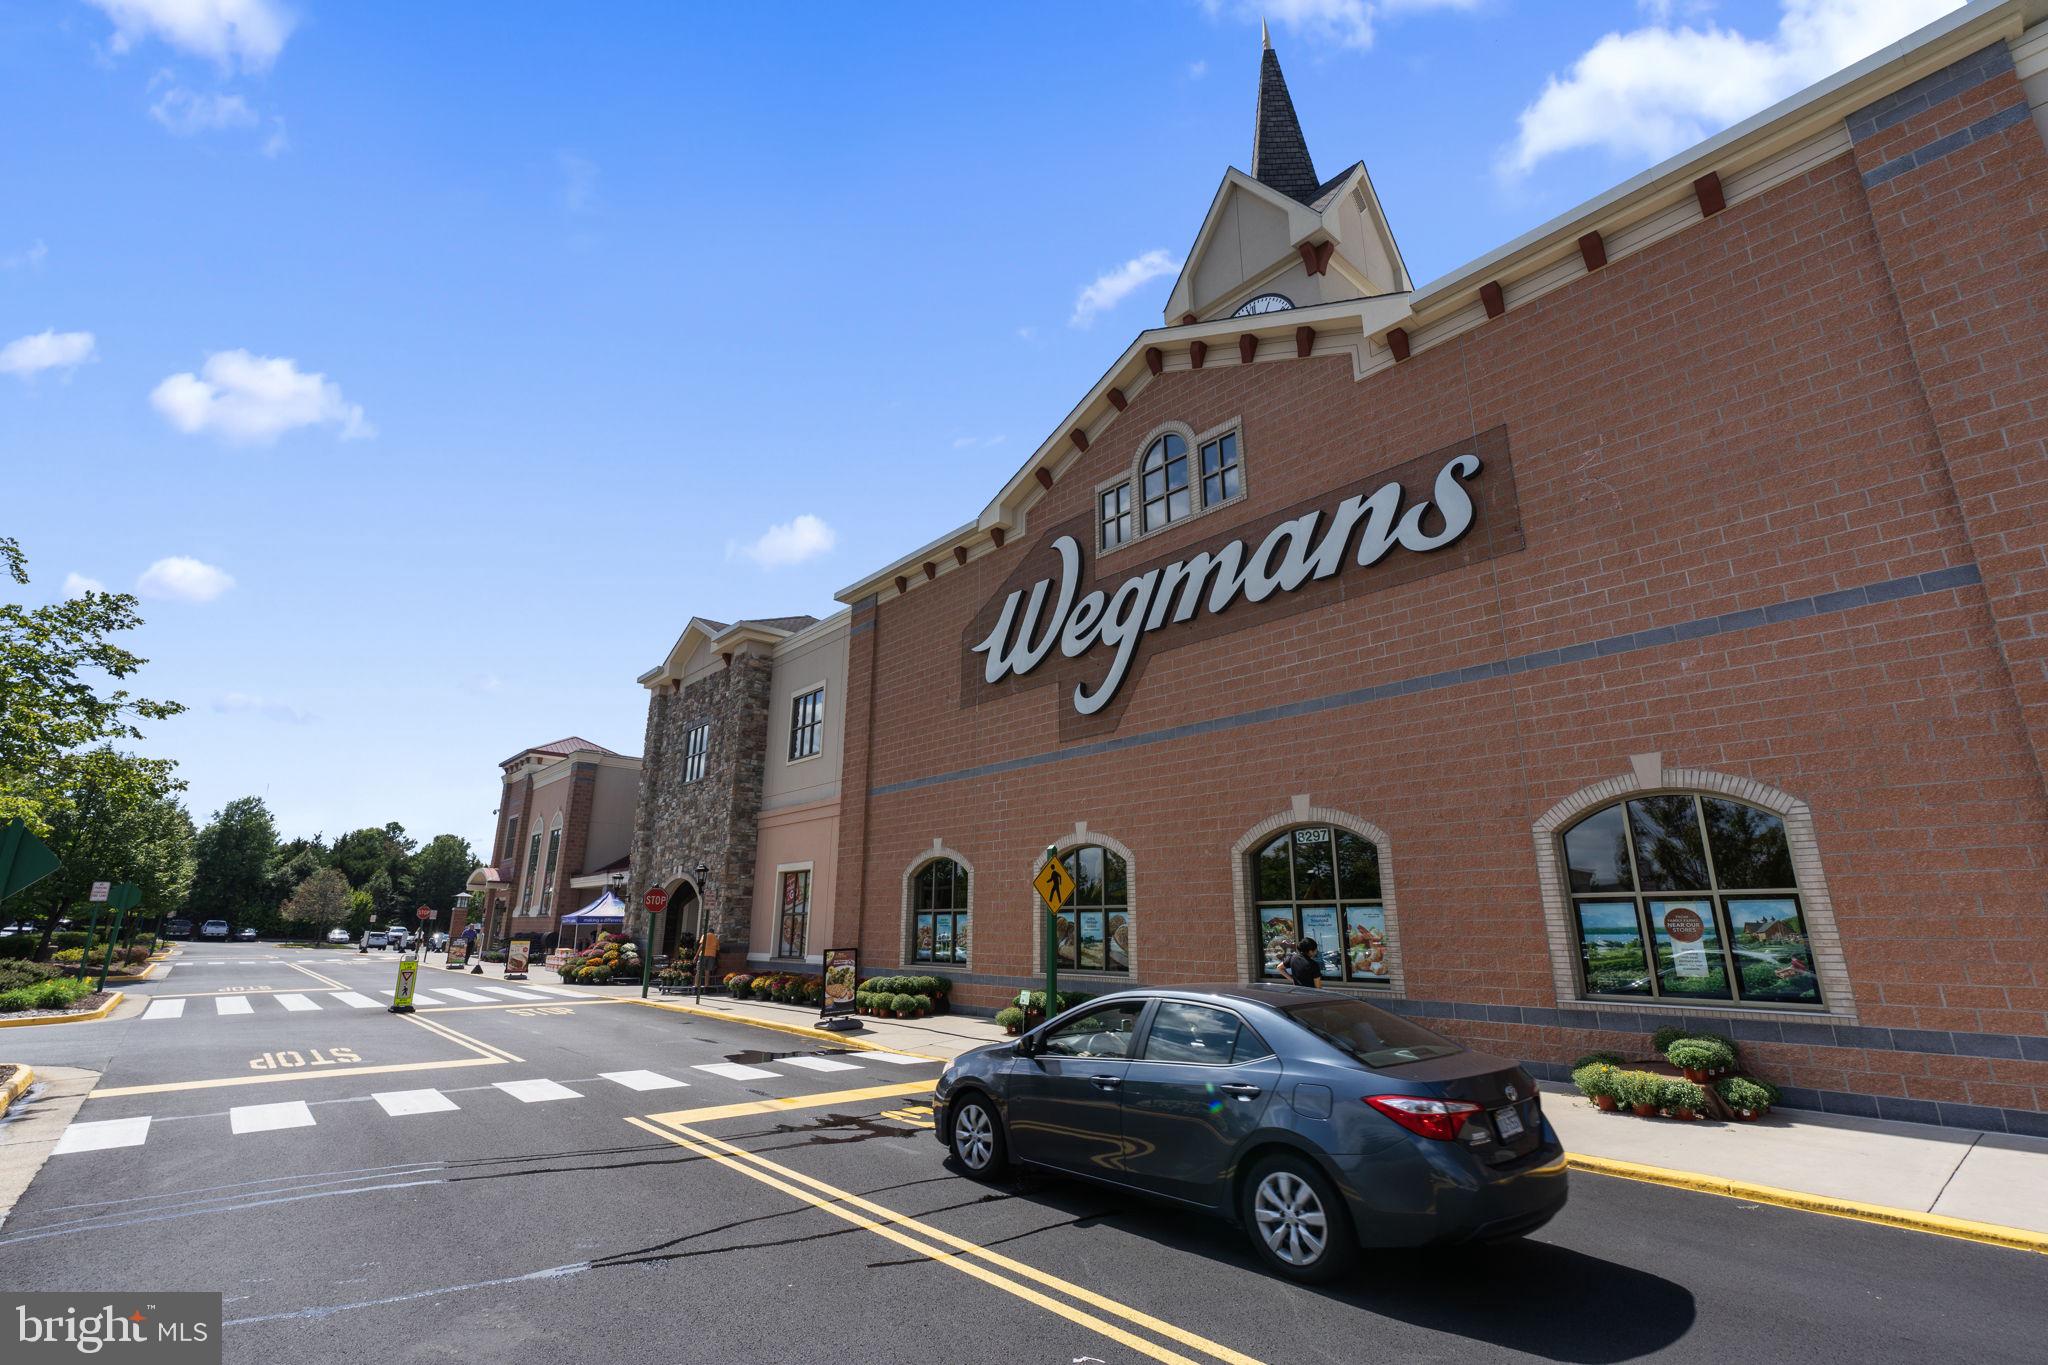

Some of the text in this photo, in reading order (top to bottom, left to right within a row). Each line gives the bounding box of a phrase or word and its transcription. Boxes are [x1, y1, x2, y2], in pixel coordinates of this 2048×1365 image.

[972, 454, 1484, 715] Wegmans
[1297, 830, 1327, 842] 8297
[646, 895, 666, 905] STOP
[505, 1007, 576, 1017] STOP
[250, 1047, 362, 1070] STOP
